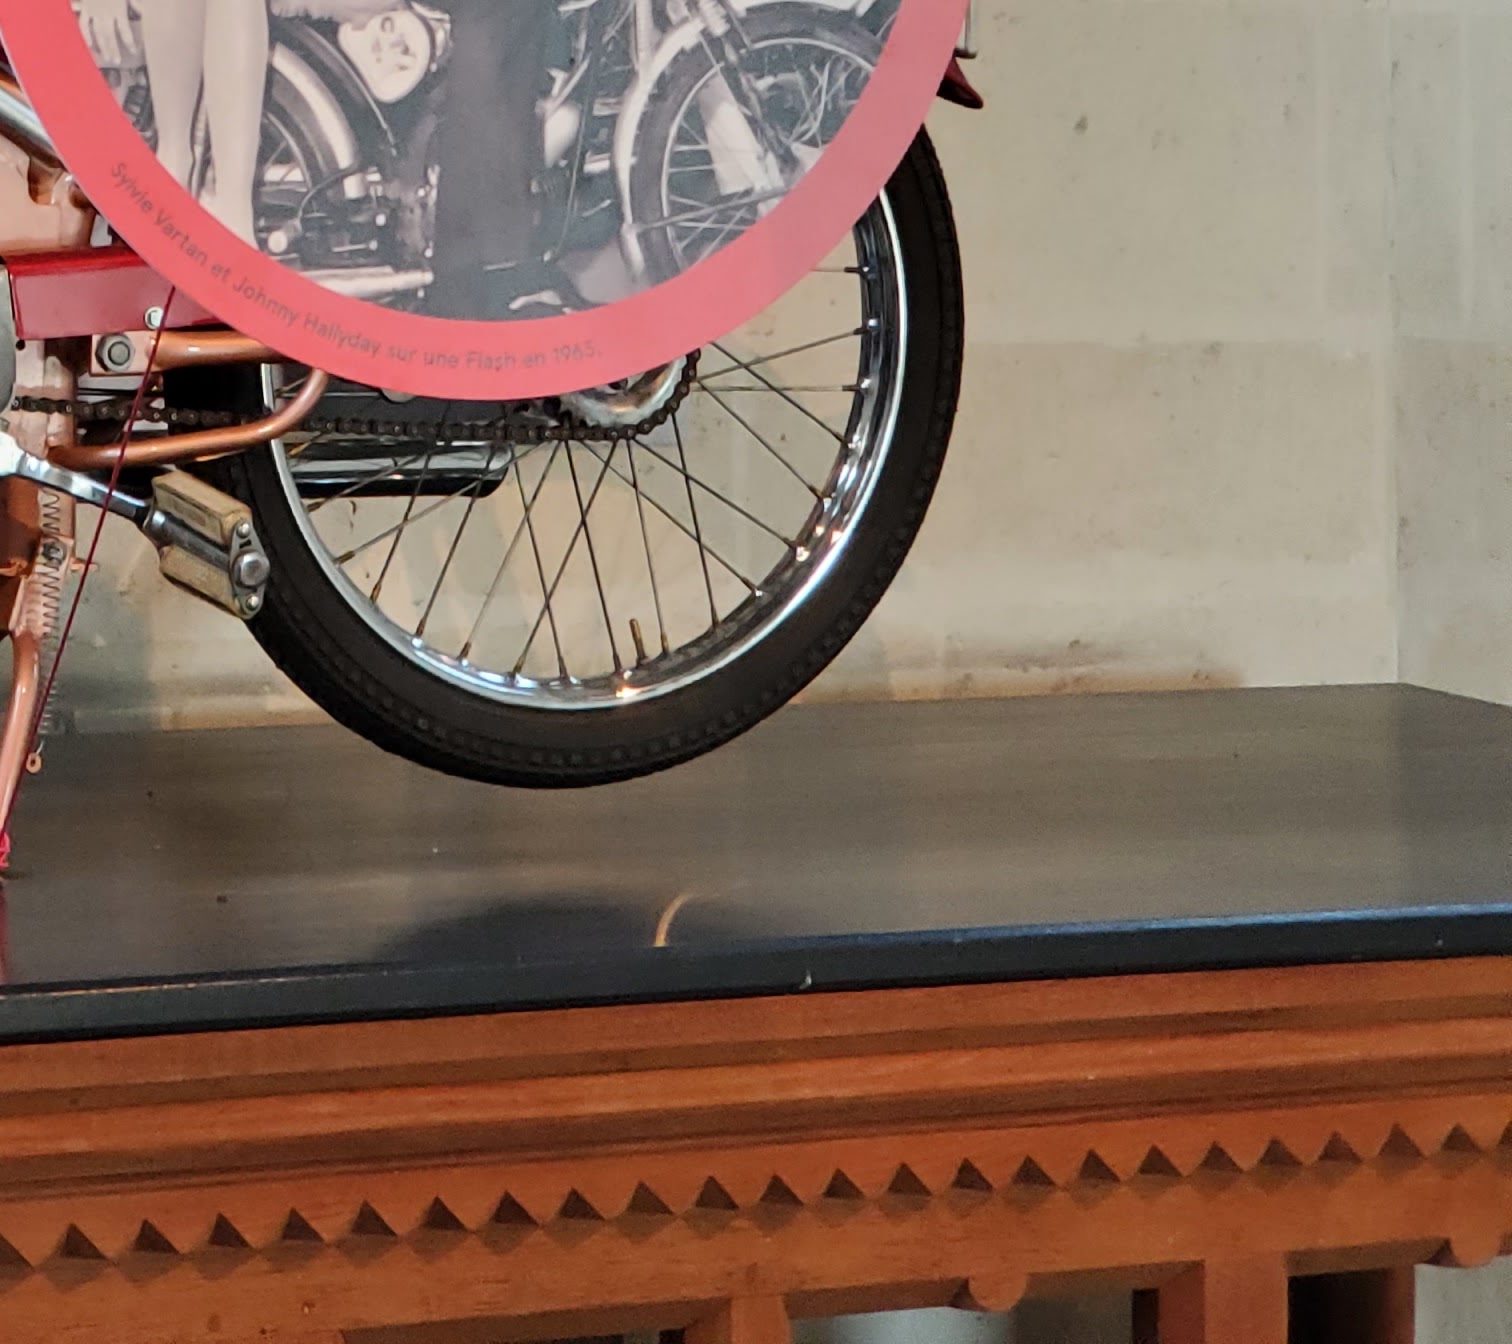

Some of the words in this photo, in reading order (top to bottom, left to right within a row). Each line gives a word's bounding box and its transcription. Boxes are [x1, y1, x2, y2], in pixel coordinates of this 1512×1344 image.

[110, 162, 154, 213] Sylvie
[152, 207, 208, 268] Vartan
[209, 261, 232, 283] et
[232, 277, 299, 326] Johnny
[303, 312, 382, 358] Hallyday
[385, 344, 418, 362] sur
[423, 351, 459, 368] une
[465, 349, 517, 371] Flash
[521, 351, 548, 369] en
